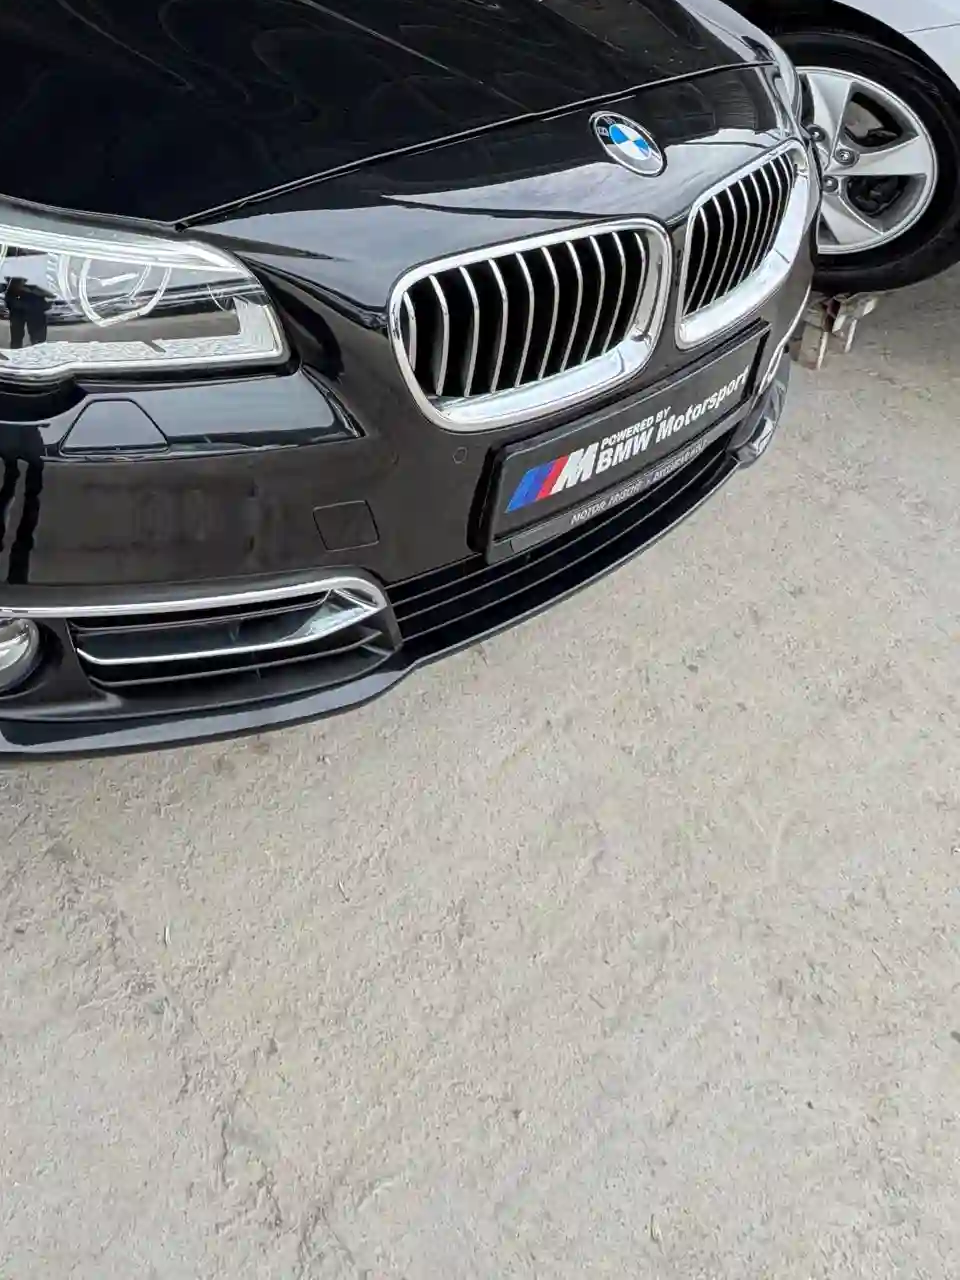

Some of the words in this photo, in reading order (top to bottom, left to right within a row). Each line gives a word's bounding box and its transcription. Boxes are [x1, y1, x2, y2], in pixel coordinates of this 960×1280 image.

[595, 430, 653, 475] BMW
[655, 365, 750, 445] Motorsport
[600, 415, 654, 450] POWERED
[655, 406, 671, 423] BY
